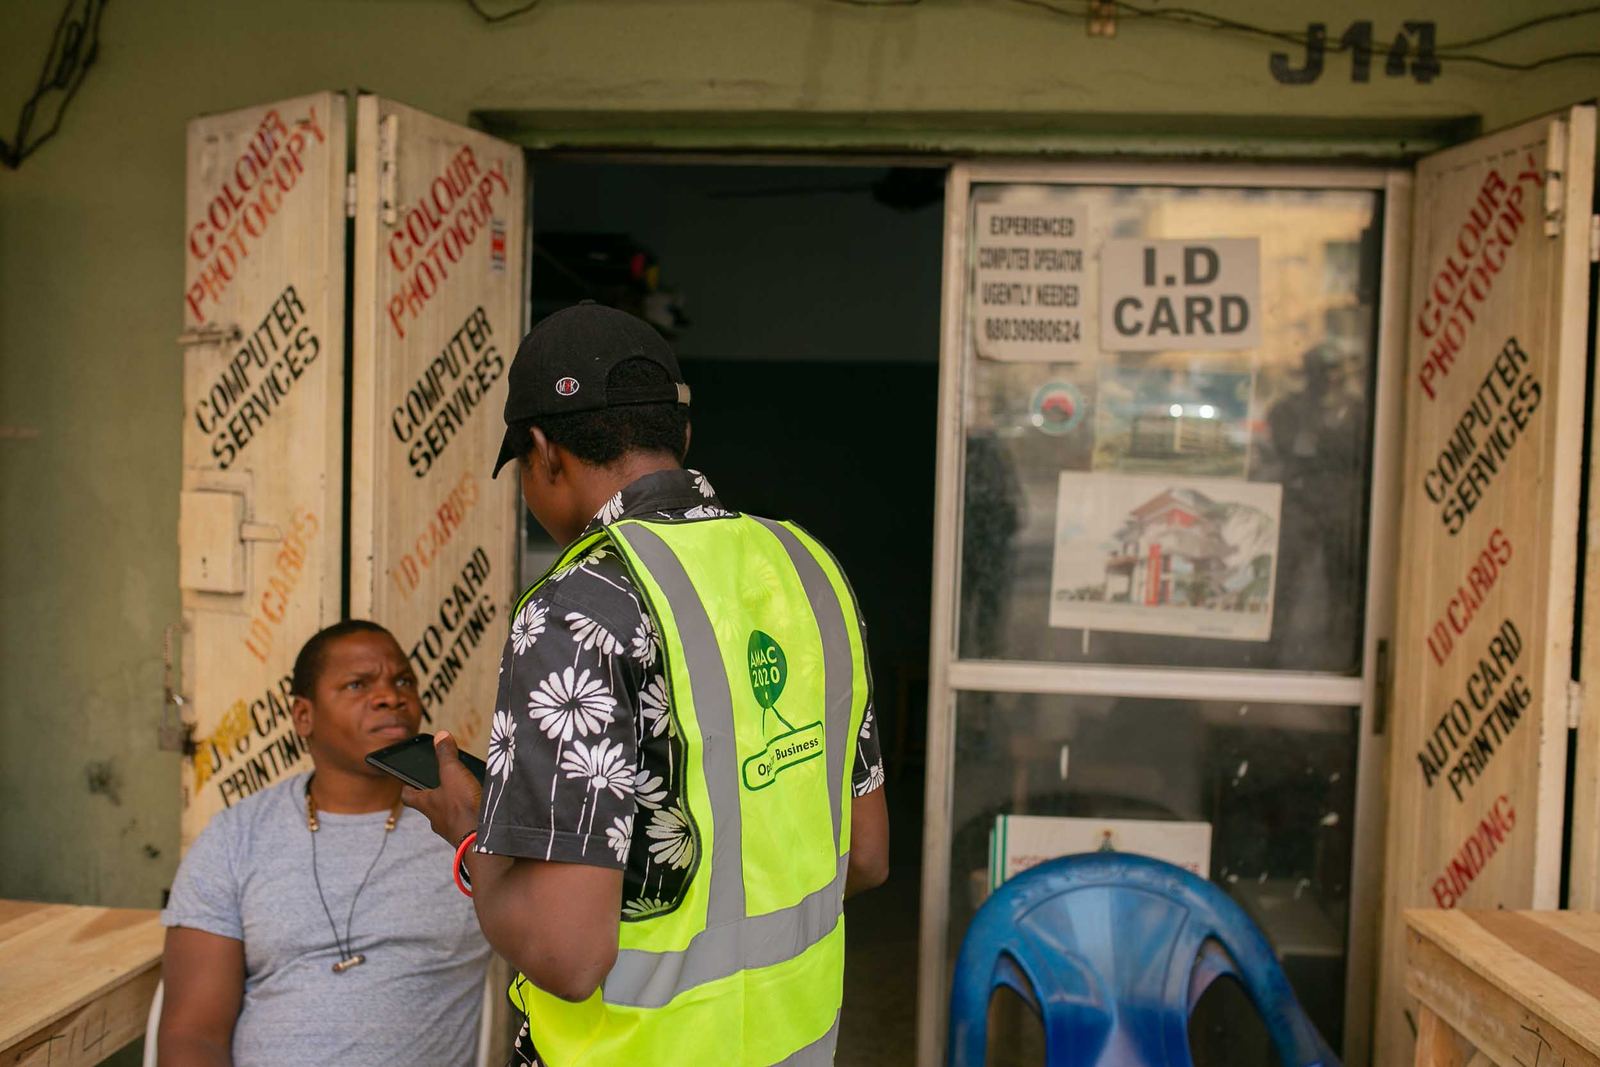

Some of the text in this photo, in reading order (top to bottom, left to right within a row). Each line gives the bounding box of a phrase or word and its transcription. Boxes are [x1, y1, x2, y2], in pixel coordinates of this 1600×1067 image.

[1269, 20, 1441, 84] J14
[186, 105, 325, 323] PHOTOCOPY
[190, 110, 289, 261] COLOUR
[387, 144, 481, 272] COLOUR
[990, 215, 1074, 238] EXPERIENCED
[386, 160, 509, 340] PHOTOCOPY
[978, 247, 1084, 273] COMPUTER OPERATOR
[1037, 284, 1080, 308] NEEDED
[1143, 246, 1220, 287] I.D
[1416, 169, 1508, 338] COLOUR
[1417, 152, 1544, 401] PHOTOCOPY
[195, 285, 307, 434] COMPUTER
[392, 305, 494, 444] COMPUTER
[1113, 295, 1250, 337] CARD
[211, 326, 320, 470] SERVICES
[408, 346, 504, 478] SERVICES
[1424, 336, 1528, 505] COMPUTER
[1441, 373, 1542, 537] SERVICES
[415, 471, 479, 570] CARDS
[439, 547, 490, 634] CARD
[1427, 528, 1513, 667] ID CARDS
[251, 675, 295, 737] CAR
[420, 595, 496, 725] PRINTING
[750, 646, 778, 668] AMAC
[752, 666, 780, 688] 2020
[1417, 618, 1523, 788] AUTO CARD
[218, 730, 308, 809] PRINTIN
[775, 738, 819, 760] Business
[1447, 674, 1532, 803] PRINTING
[1431, 794, 1517, 909] BINDING
